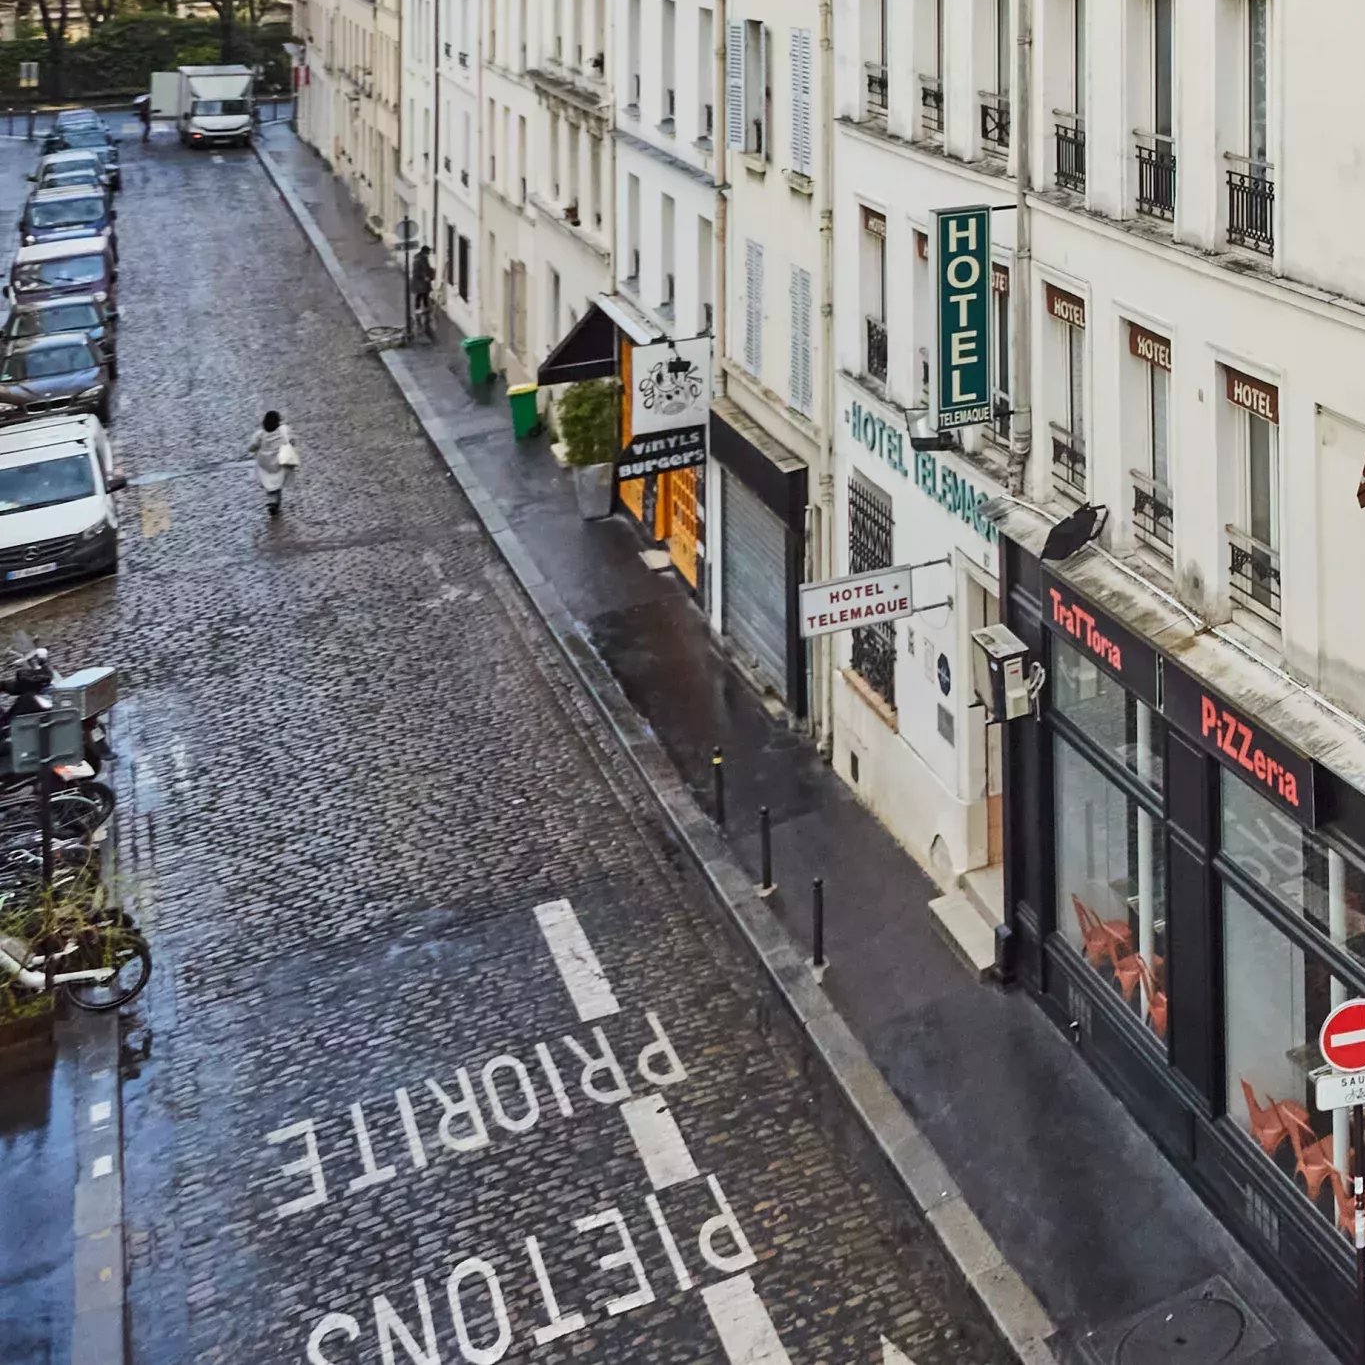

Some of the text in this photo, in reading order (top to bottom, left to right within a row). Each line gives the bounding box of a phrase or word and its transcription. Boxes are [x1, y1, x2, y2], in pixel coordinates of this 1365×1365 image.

[947, 218, 980, 403] HOTEL
[1053, 296, 1085, 327] HOTEL
[1136, 336, 1172, 369] HOTEL
[1233, 379, 1274, 418] HOTEL
[940, 406, 989, 427] TELEMAQUE
[850, 400, 908, 479] HOTEL
[829, 582, 884, 604] HOTEL
[807, 597, 908, 629] TELEMAQUE
[267, 1011, 689, 1218] PRIORITE
